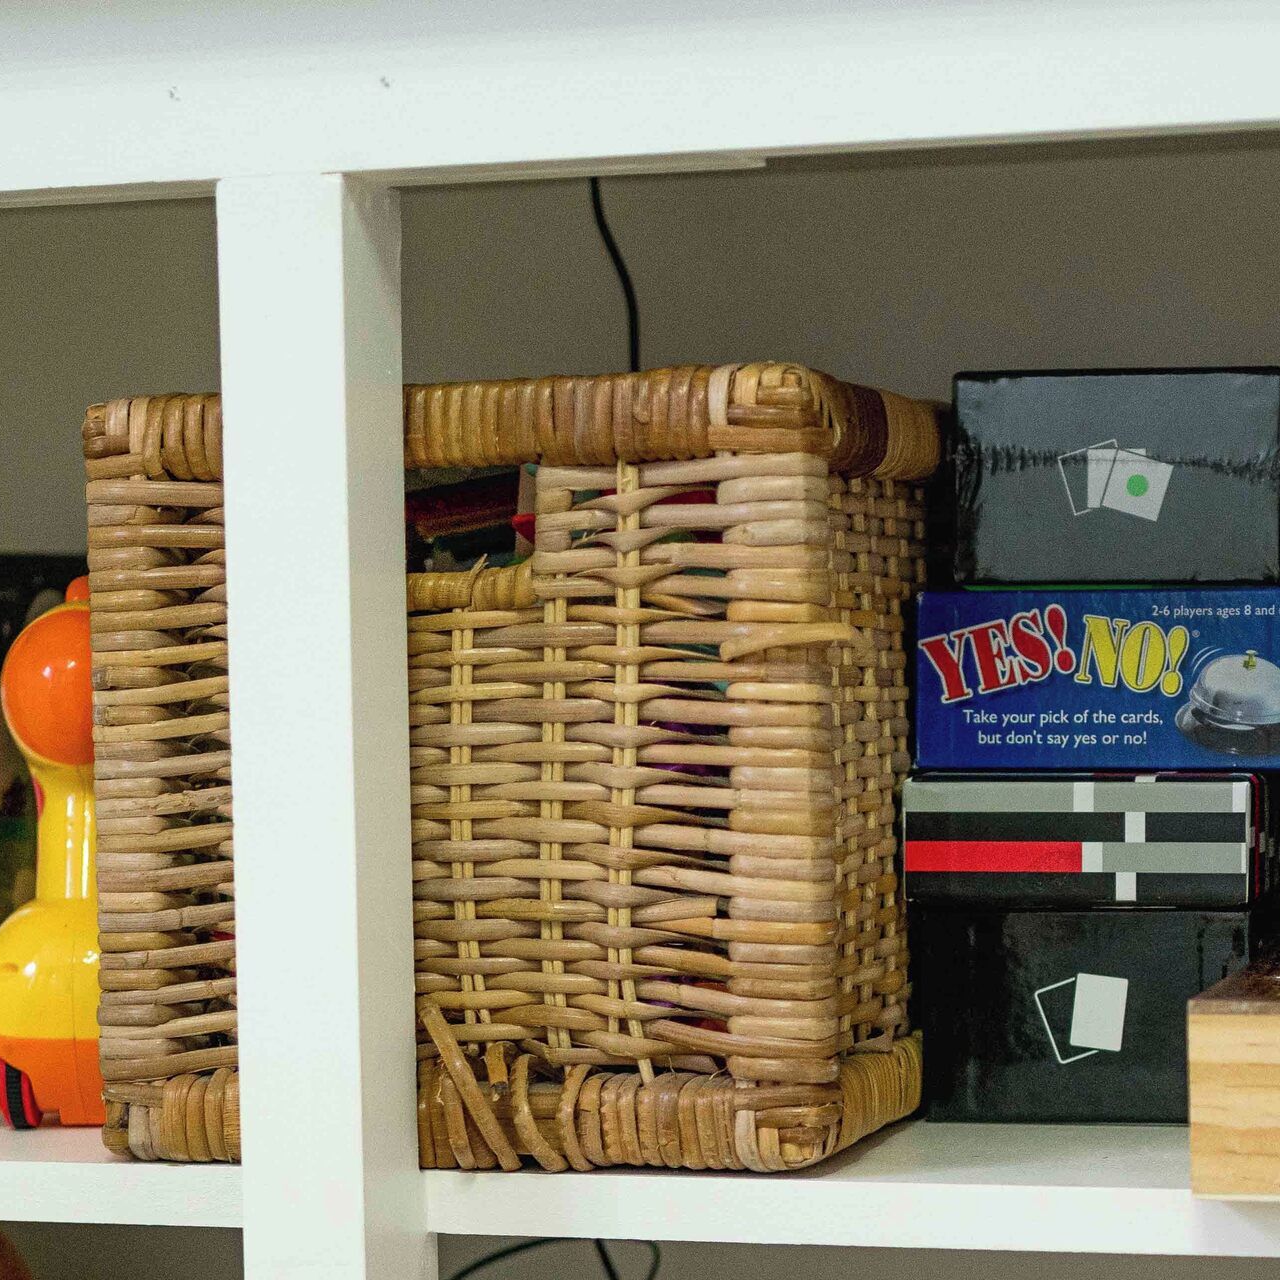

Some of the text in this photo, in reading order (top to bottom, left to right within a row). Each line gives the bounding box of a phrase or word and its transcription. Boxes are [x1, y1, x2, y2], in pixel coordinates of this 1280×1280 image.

[1152, 605, 1171, 618] 2-6
[1173, 605, 1213, 618] players
[1216, 606, 1242, 619] ages
[1244, 605, 1252, 617] 8
[1254, 605, 1276, 617] and
[919, 604, 1190, 704] YES! NO!
[963, 709, 1163, 728] Take your pick of the cards,
[978, 730, 1148, 749] but don't say yes or no!
